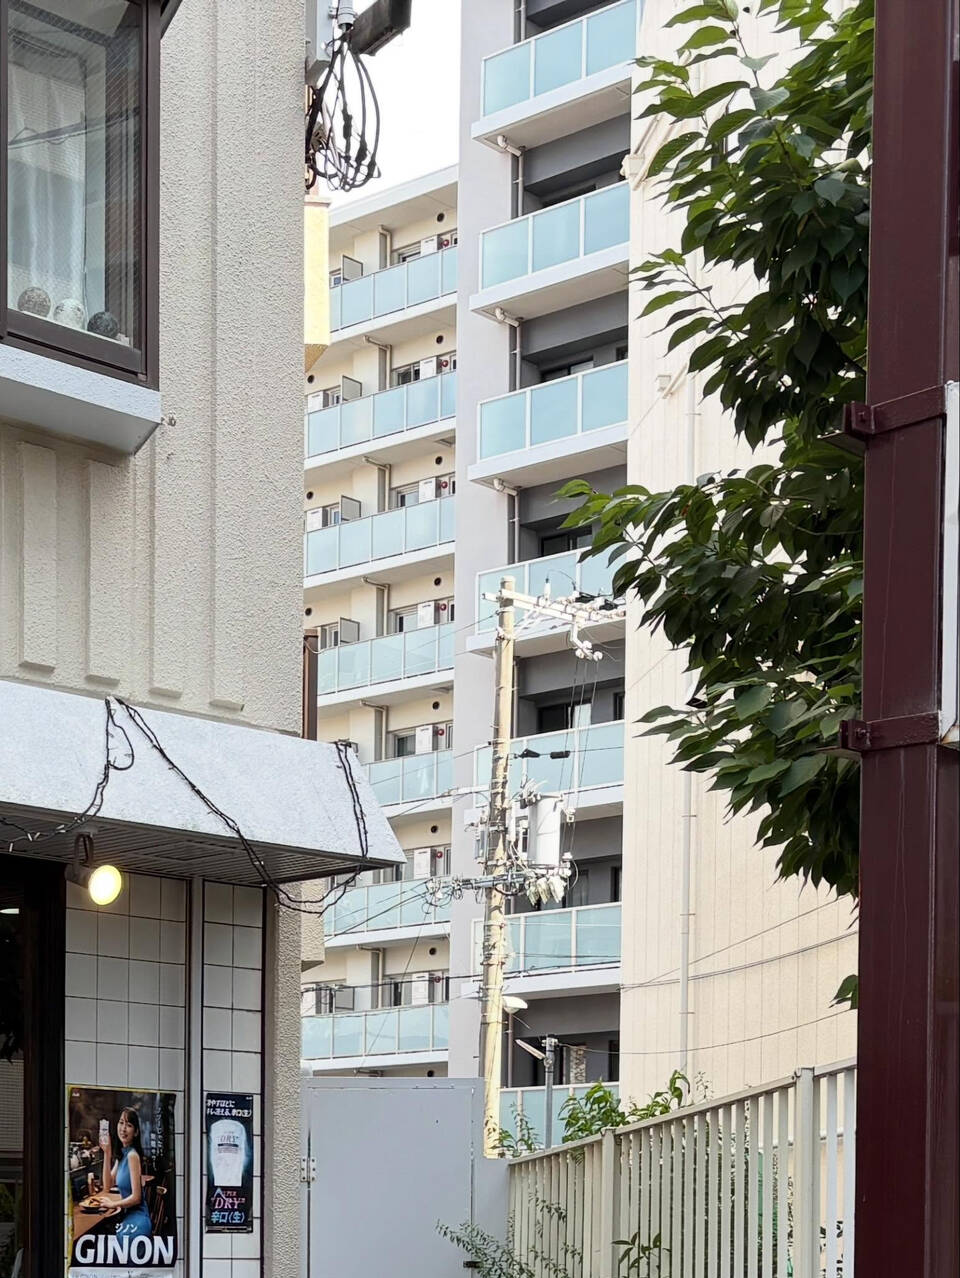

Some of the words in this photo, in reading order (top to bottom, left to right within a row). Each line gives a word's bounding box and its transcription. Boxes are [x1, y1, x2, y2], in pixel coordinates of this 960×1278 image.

[115, 1222, 138, 1233] ジノン
[75, 1234, 174, 1265] GINON
